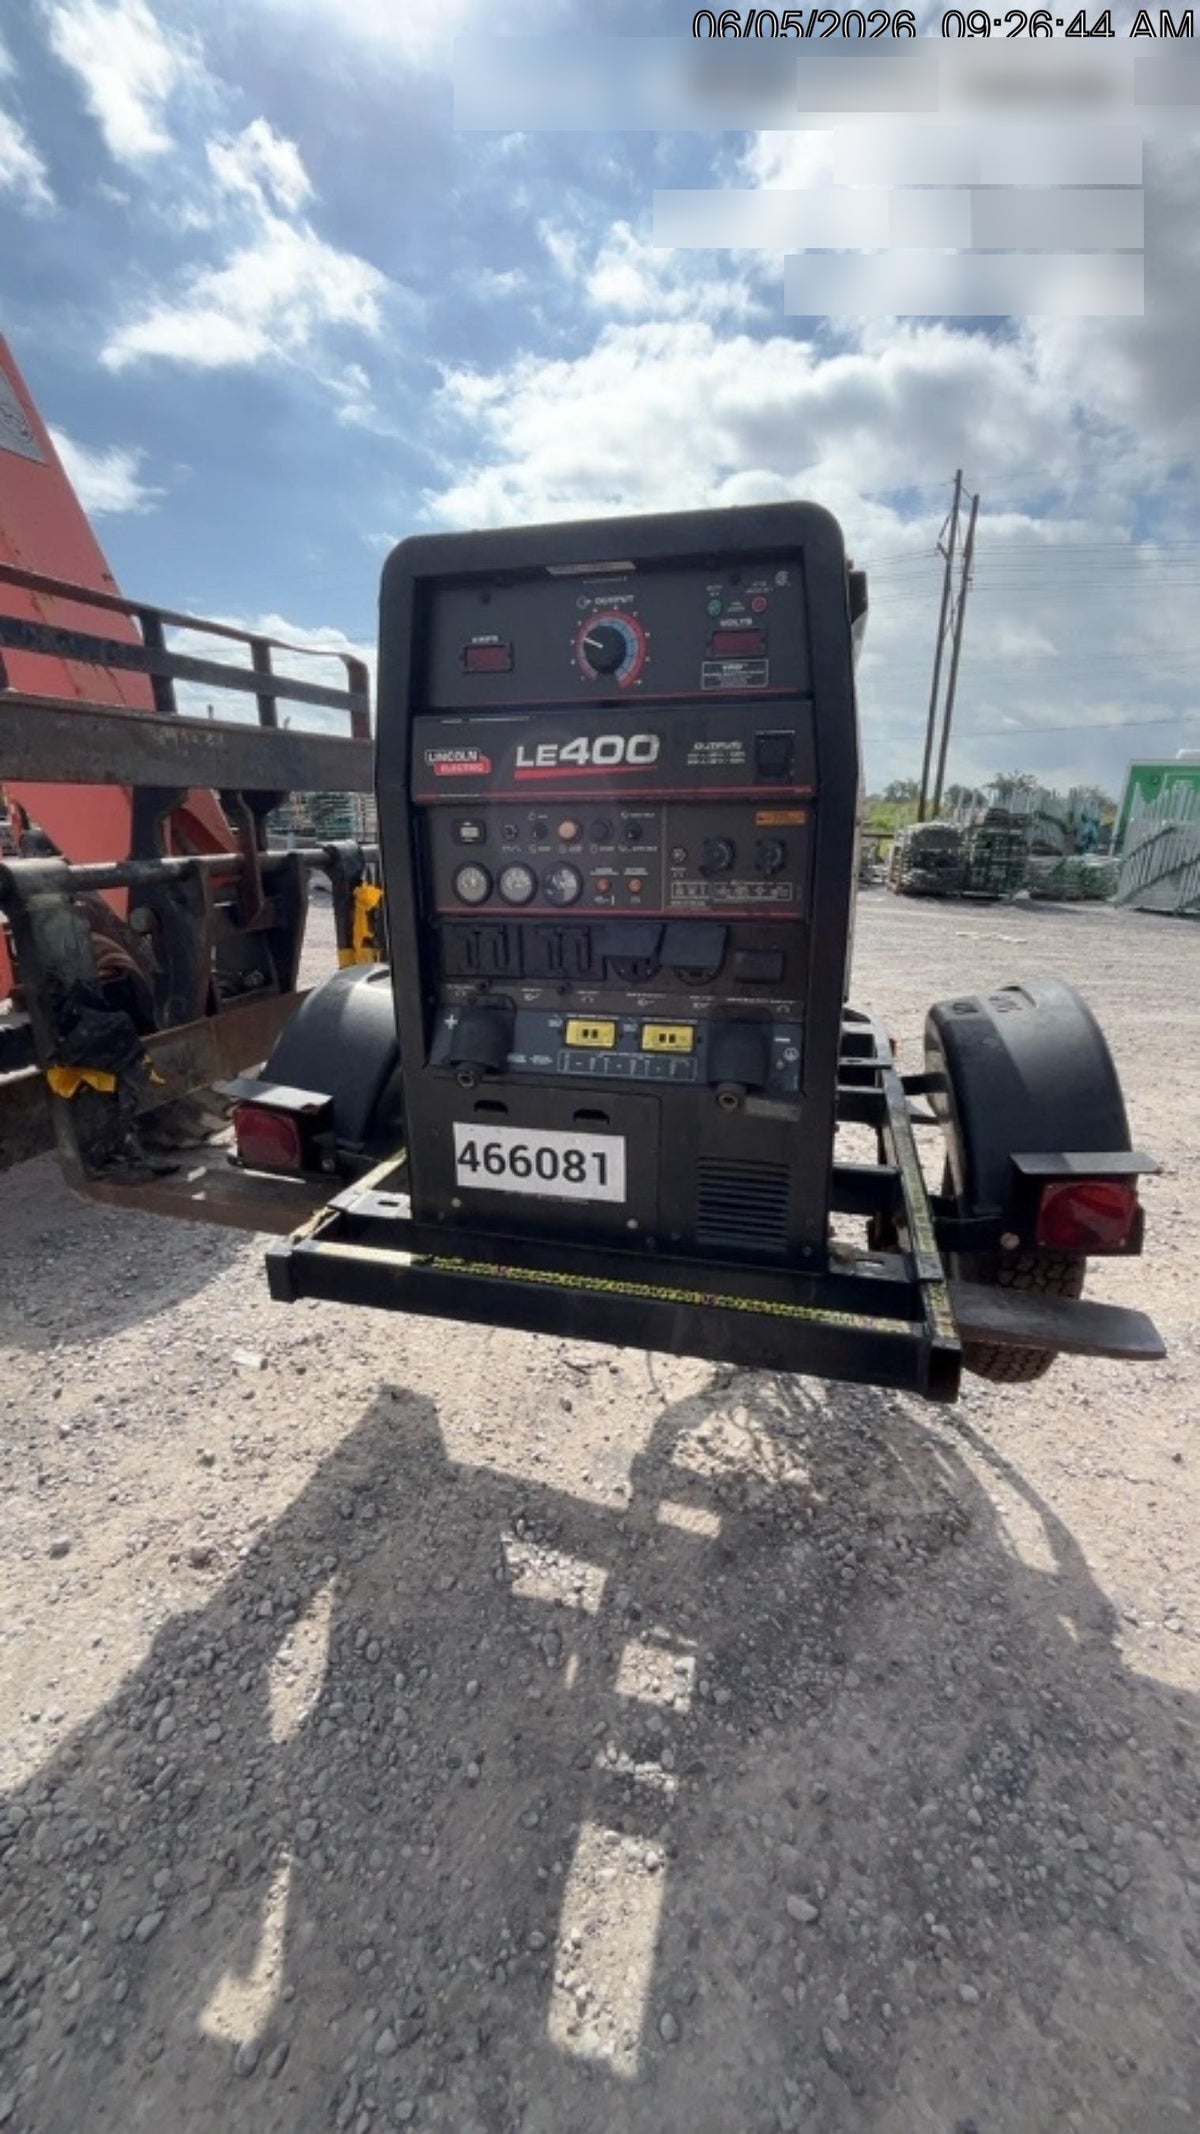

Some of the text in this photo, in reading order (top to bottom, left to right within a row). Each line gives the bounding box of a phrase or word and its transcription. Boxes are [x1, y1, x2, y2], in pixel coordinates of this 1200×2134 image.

[428, 750, 478, 763] LINCOLN
[515, 733, 661, 767] LE400
[440, 762, 485, 774] ELECTRIC
[457, 1140, 607, 1187] 466081
